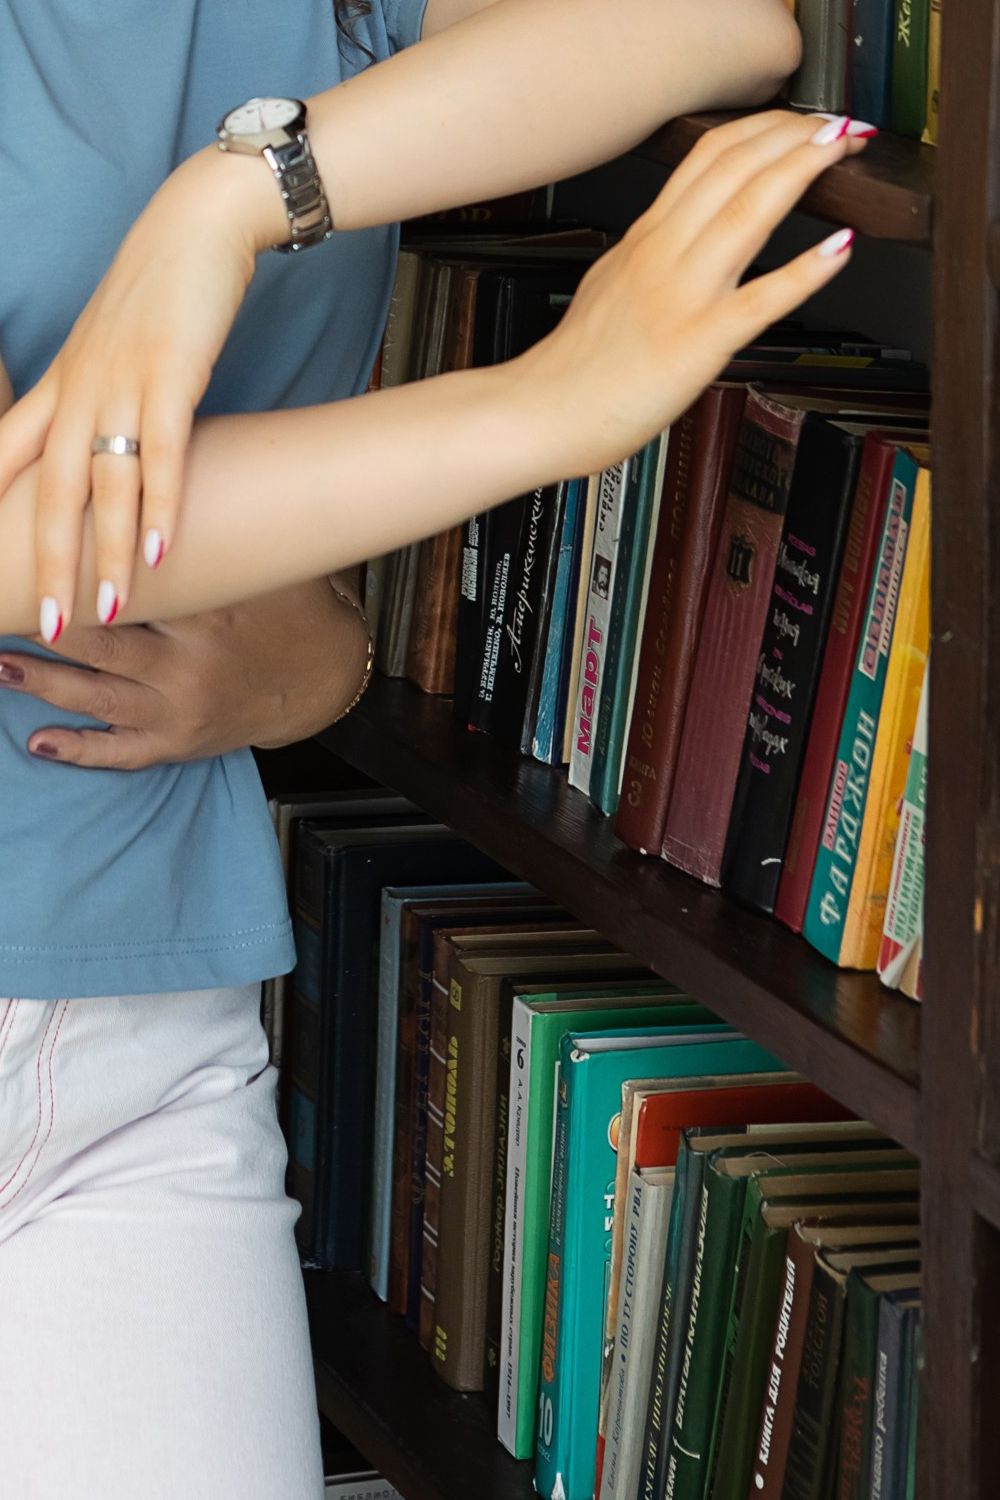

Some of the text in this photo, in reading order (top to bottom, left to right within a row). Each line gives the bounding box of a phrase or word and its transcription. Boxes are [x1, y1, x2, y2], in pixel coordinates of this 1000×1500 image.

[467, 547, 478, 602] КОСМИЗМ
[486, 627, 503, 692] НЕМЧЕНКО,
[628, 780, 642, 808] 3
[818, 707, 875, 927] ФАРДЖОН
[823, 760, 848, 850] ЭЛИНОР
[893, 814, 921, 939] ВАРИАНТОВ
[514, 1105, 523, 1147] Кредер
[632, 1186, 643, 1217] РВА
[624, 1222, 639, 1298] СТОРОНУ
[541, 1251, 560, 1385] ФИЗИКА
[620, 1324, 630, 1350] ПО
[622, 1298, 632, 1320] ТУ
[675, 1181, 710, 1430] БРАТЬЯ КАРАМАЗОВЫ
[758, 1254, 797, 1466] КНИГА ДЛЯ РОДИТЕЛЕЙ
[539, 1391, 553, 1447] 10
